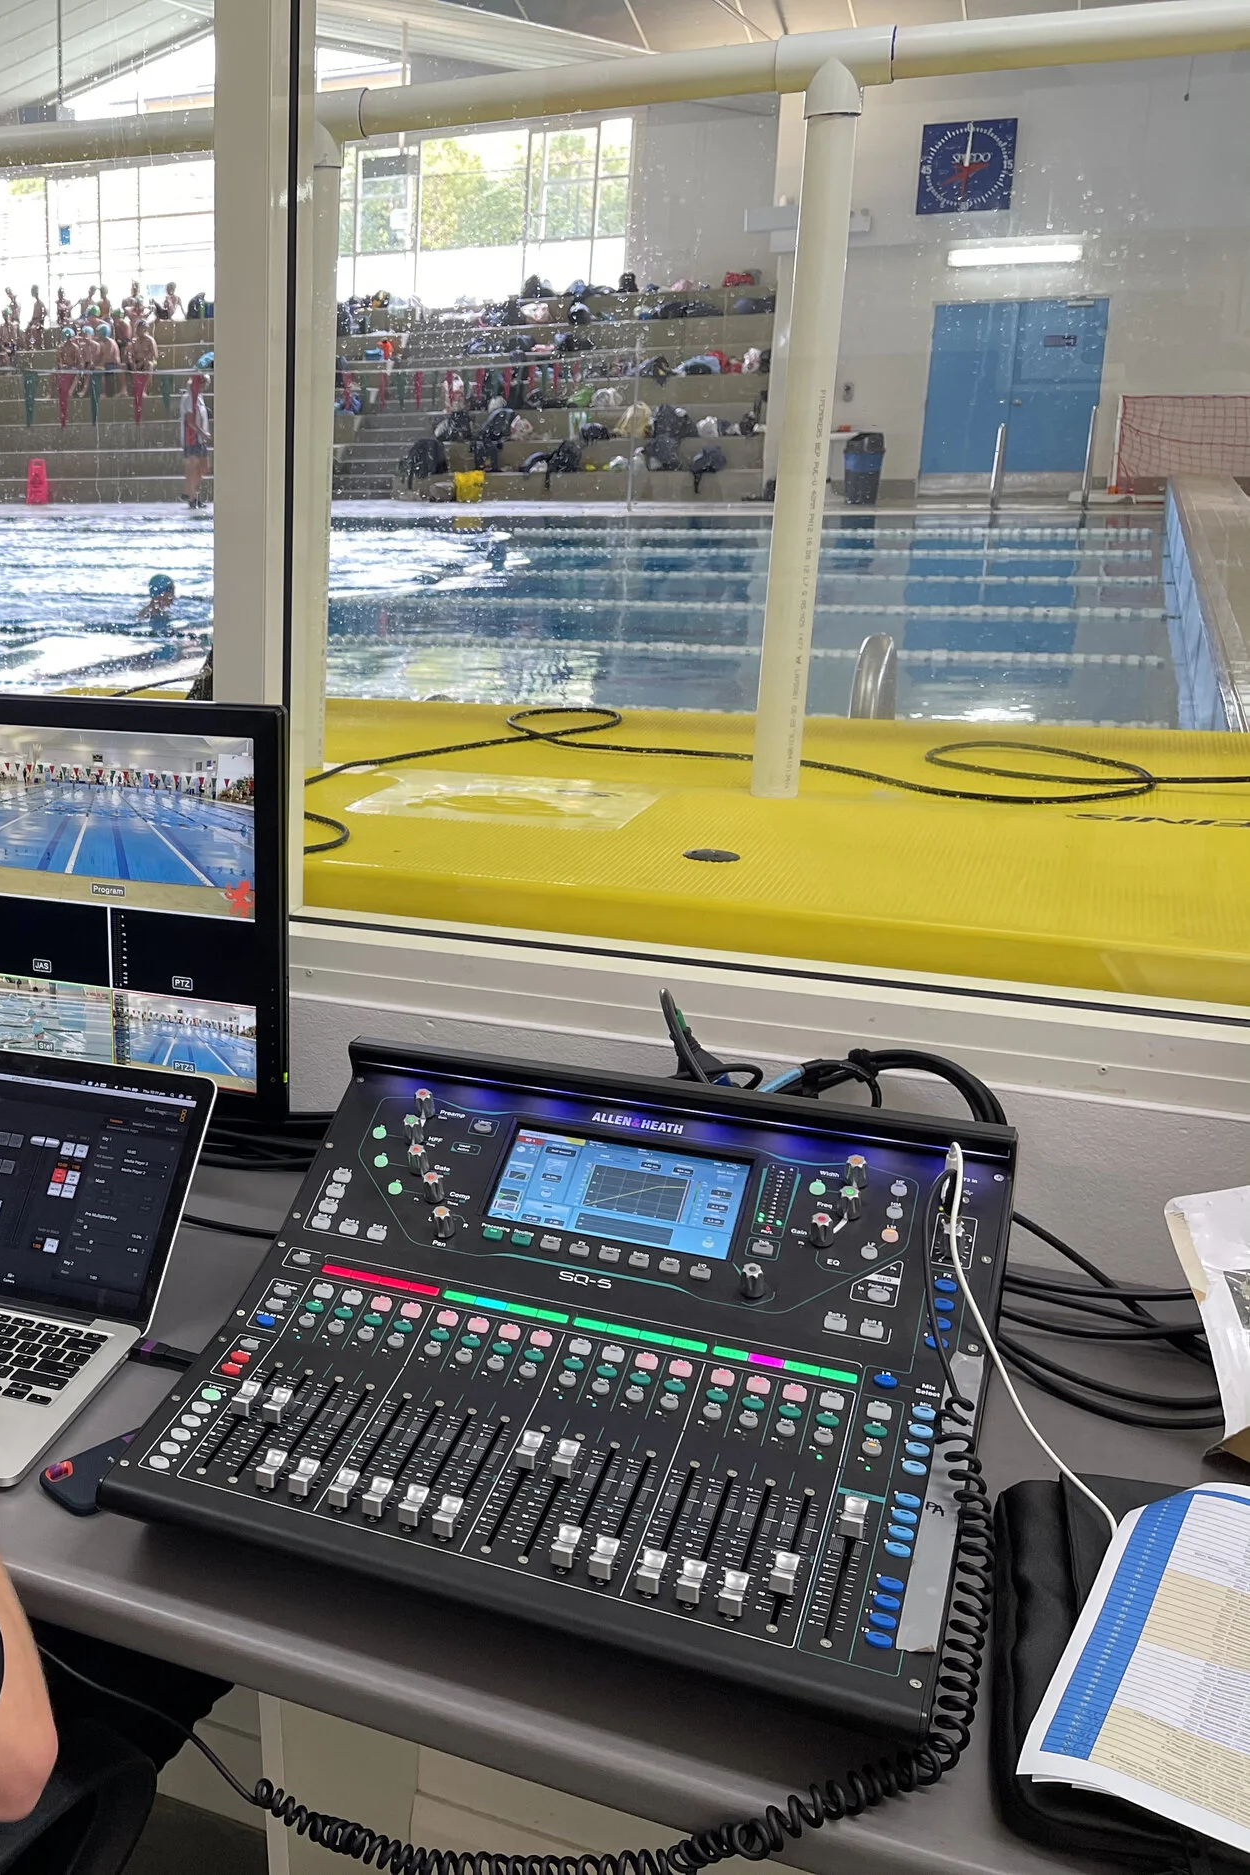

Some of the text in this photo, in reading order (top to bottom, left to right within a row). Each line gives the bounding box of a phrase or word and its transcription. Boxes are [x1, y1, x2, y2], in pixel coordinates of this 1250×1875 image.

[952, 152, 991, 164] SPEDO
[1003, 160, 1013, 169] 15
[93, 886, 124, 895] Program
[34, 962, 49, 970] JAS
[175, 979, 190, 987] PTZ
[175, 1063, 194, 1071] PTZ3
[440, 1109, 466, 1119] Preamp
[591, 1111, 684, 1135] ALLEN&HEATH
[434, 1164, 450, 1172] Gate
[819, 1170, 839, 1178] Width
[449, 1191, 471, 1201] Comp
[816, 1202, 833, 1210] Freq
[481, 1222, 511, 1234] Processing
[791, 1228, 808, 1236] Gain
[513, 1228, 535, 1238] Routing
[432, 1239, 447, 1248] Pan
[826, 1259, 840, 1267] EQ
[558, 1271, 612, 1290] SQ-5
[208, 1384, 227, 1392] Layers
[921, 1383, 936, 1391] Mix
[915, 1388, 941, 1398] Select
[925, 1501, 944, 1517] PA
